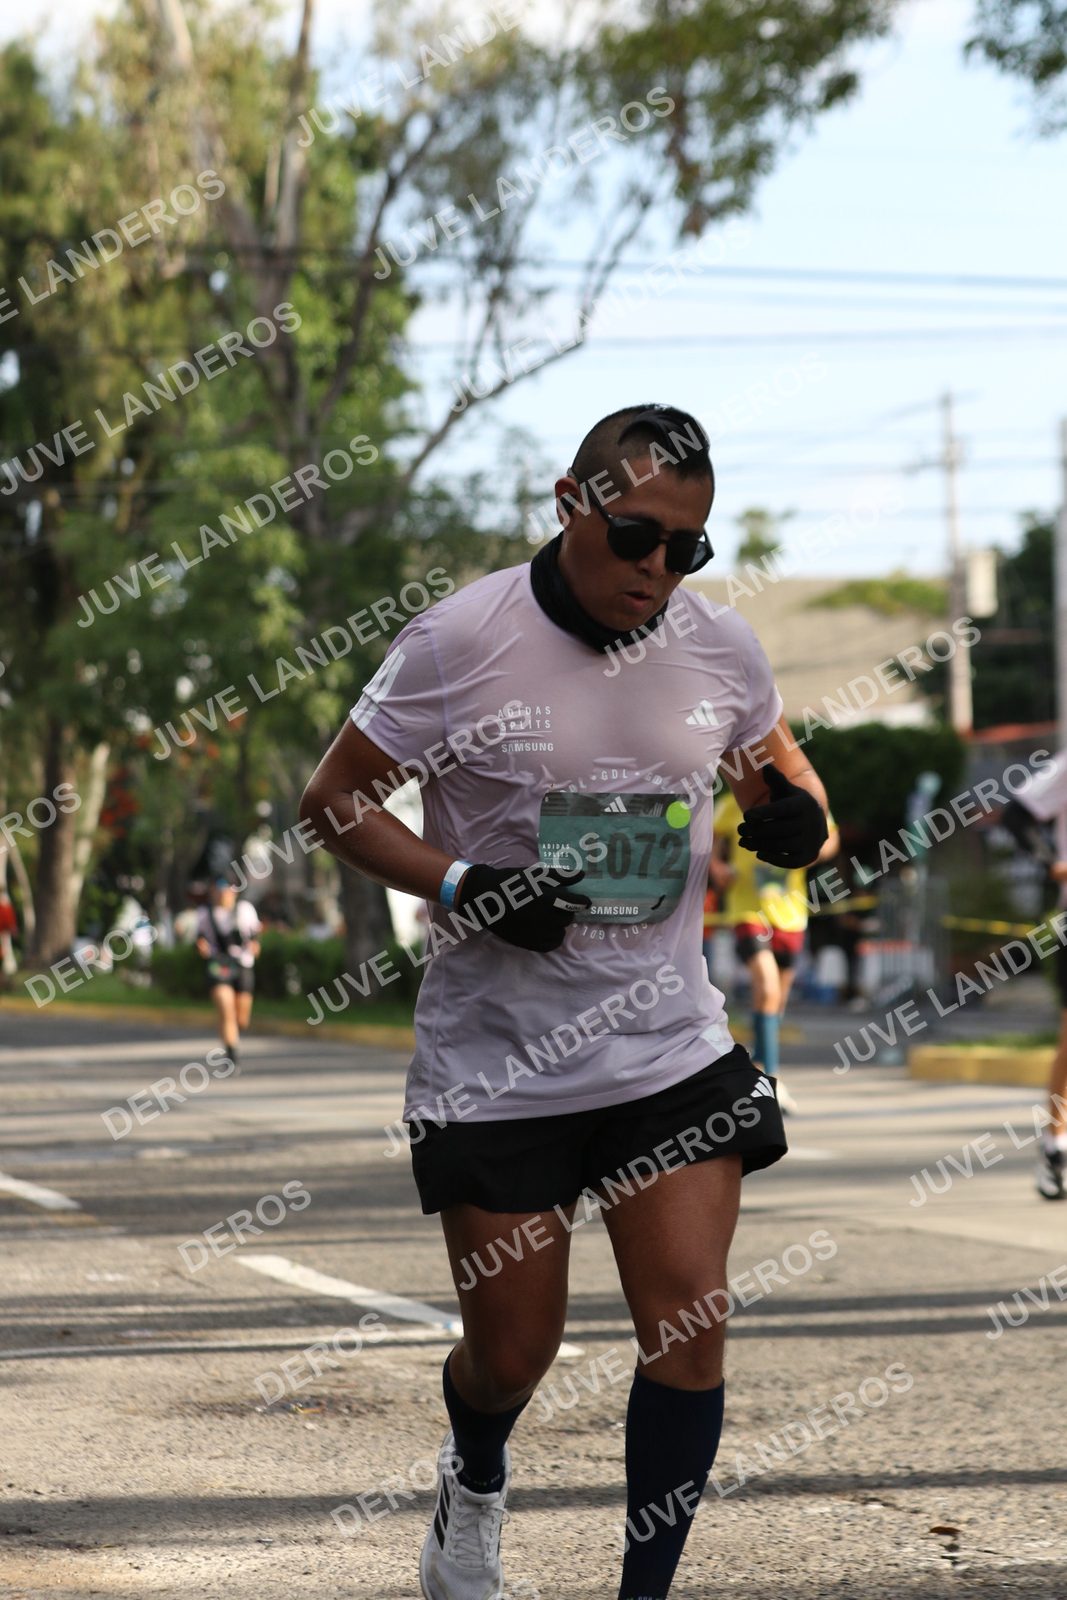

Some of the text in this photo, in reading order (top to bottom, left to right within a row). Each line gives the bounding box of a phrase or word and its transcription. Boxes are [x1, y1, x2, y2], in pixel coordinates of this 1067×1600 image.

[498, 705, 552, 720] ADIDAS
[500, 720, 551, 731] SPLITS
[501, 742, 554, 753] SAMSUNG
[601, 768, 629, 780] GDL
[590, 906, 640, 915] SAMSUNG
